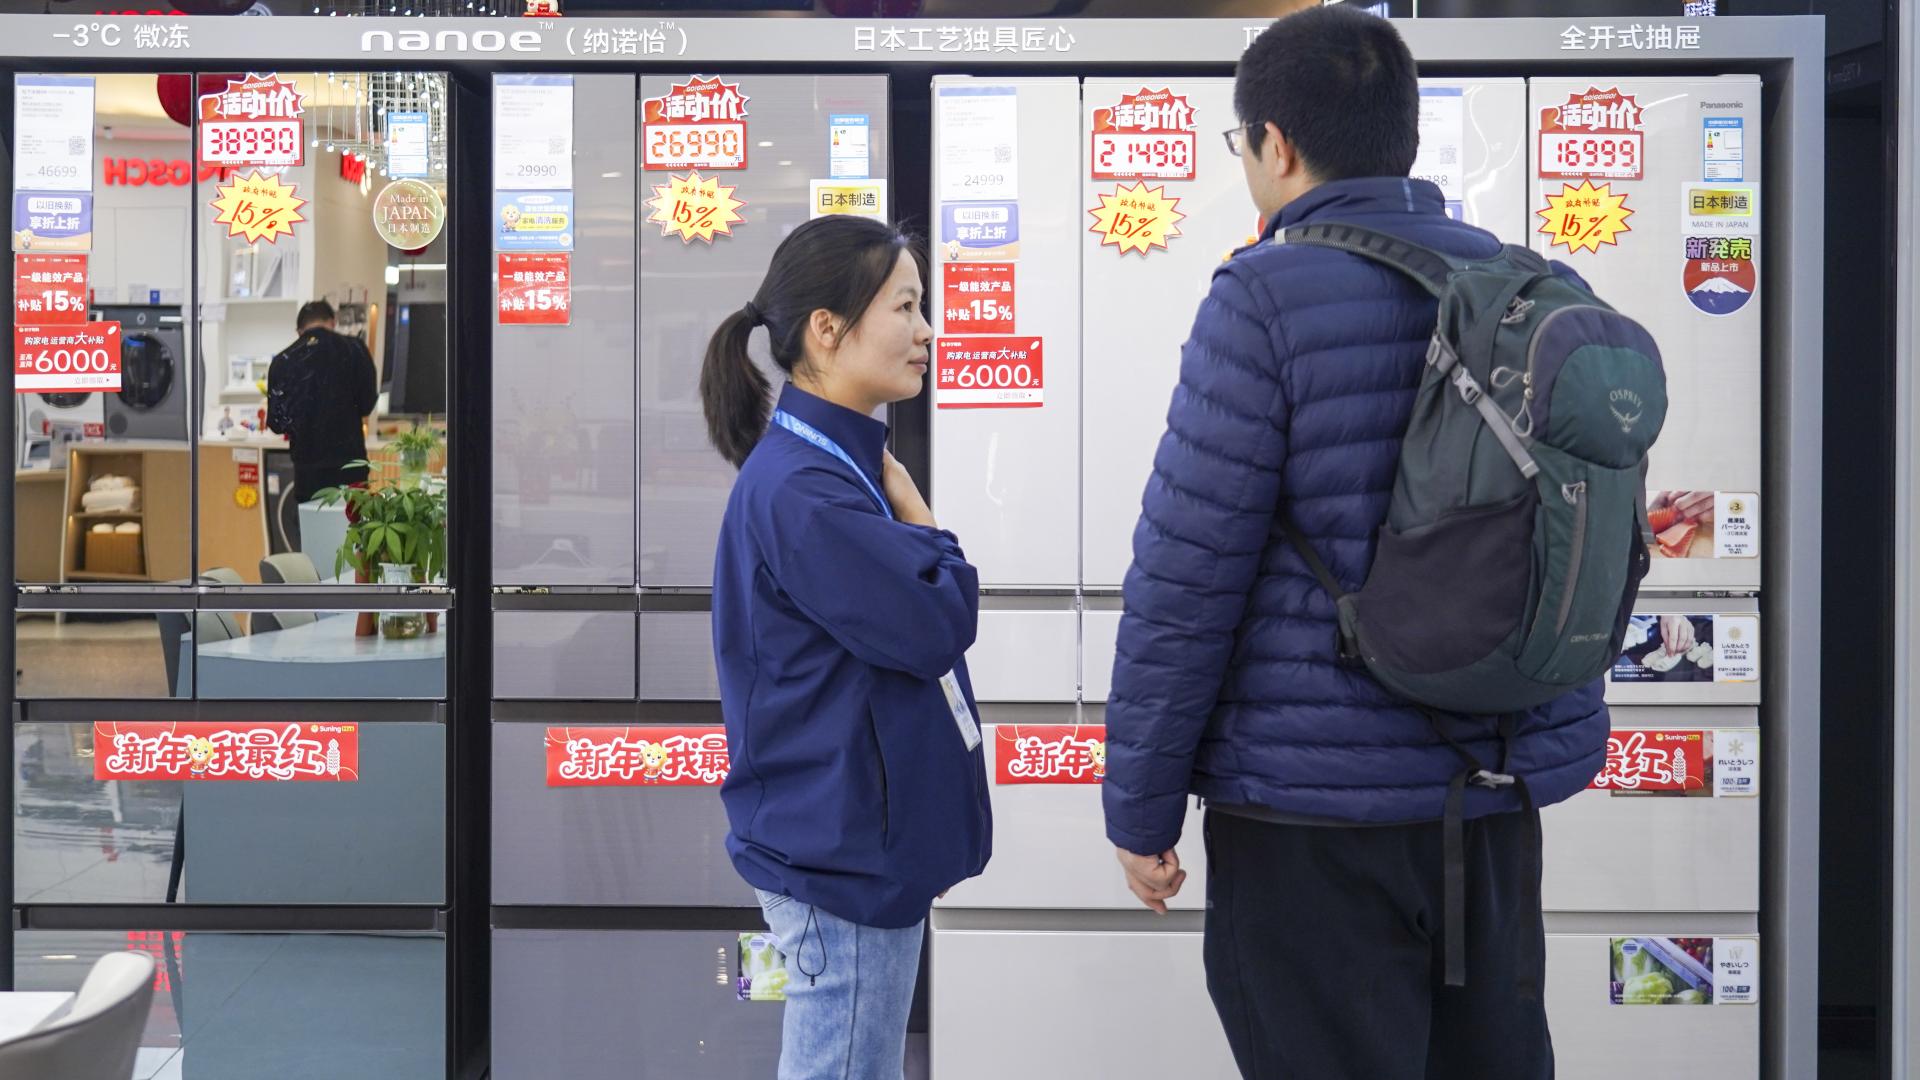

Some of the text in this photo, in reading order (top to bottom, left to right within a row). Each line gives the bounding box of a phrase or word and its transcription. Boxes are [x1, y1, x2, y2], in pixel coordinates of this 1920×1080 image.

[133, 23, 190, 49] 微冻
[361, 30, 542, 52] nanoe
[854, 25, 1076, 53] 日本工艺独具匠心
[1560, 24, 1701, 50] 全开式抽屉
[222, 86, 298, 119] 活动价
[665, 88, 741, 122] 活动价
[1562, 98, 1639, 131] 活动价
[1700, 101, 1743, 109] Panasonic
[1114, 99, 1191, 131] 活动价
[211, 127, 293, 155] 38990
[651, 129, 738, 158] 26990
[1558, 139, 1634, 166] 16999
[1100, 140, 1187, 167] 21490
[38, 165, 77, 178] 46699
[517, 164, 557, 177] 29990
[964, 174, 1004, 187] 24999
[36, 200, 73, 210] 以旧换新
[390, 194, 429, 203] Made in
[821, 192, 876, 207] 日本制造
[1693, 195, 1748, 209] 日本制造
[29, 216, 81, 230] 享折上折
[231, 200, 284, 229] 15%
[380, 205, 437, 224] JAPAN
[672, 200, 718, 229] 15%
[962, 210, 1000, 220] 以旧换新
[1109, 212, 1158, 238] 15%
[388, 223, 430, 234] 日本制造
[956, 226, 1007, 240] 享折上折
[1560, 213, 1609, 241] 15%
[1686, 236, 1751, 260] 新発売
[20, 272, 84, 283] 一级能效产品
[503, 271, 566, 283] 一级能效产品
[1701, 262, 1739, 272] 新品上市
[948, 281, 1012, 293] 一级能效产品
[35, 349, 117, 373] 6000 元
[957, 364, 1040, 388] 6000 元
[1008, 735, 1093, 778] 新年
